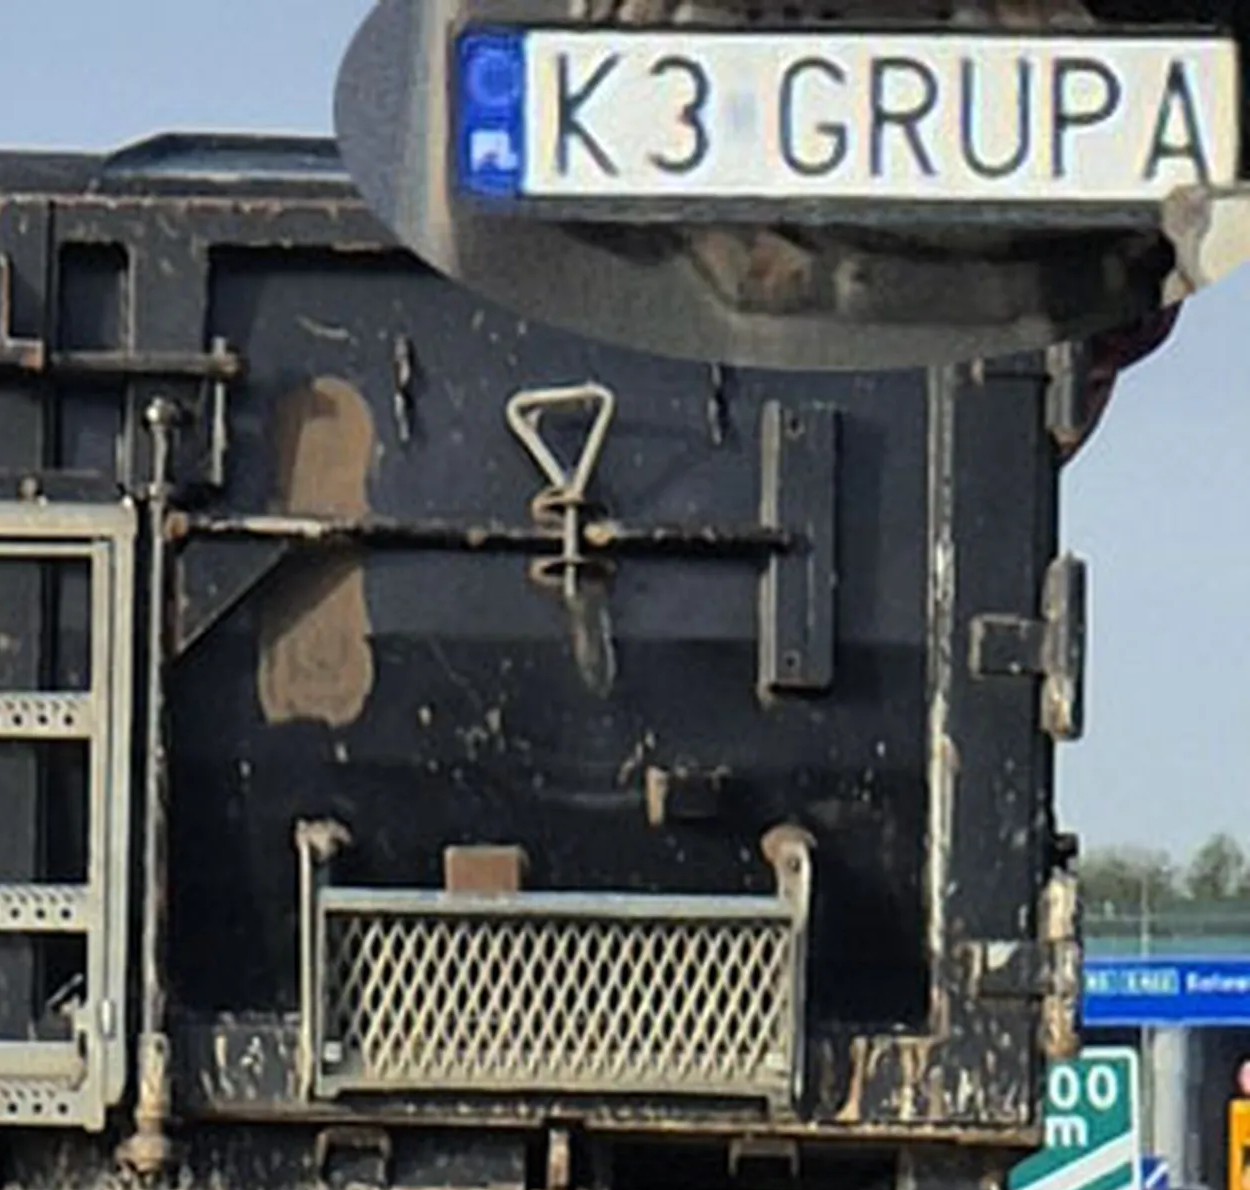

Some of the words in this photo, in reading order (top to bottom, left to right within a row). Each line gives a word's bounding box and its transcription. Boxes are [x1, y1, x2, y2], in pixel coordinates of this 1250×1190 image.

[555, 54, 710, 178] K3
[778, 56, 1213, 185] GRUPA
[1049, 1065, 1118, 1110] 00
[1046, 1115, 1088, 1147] m
